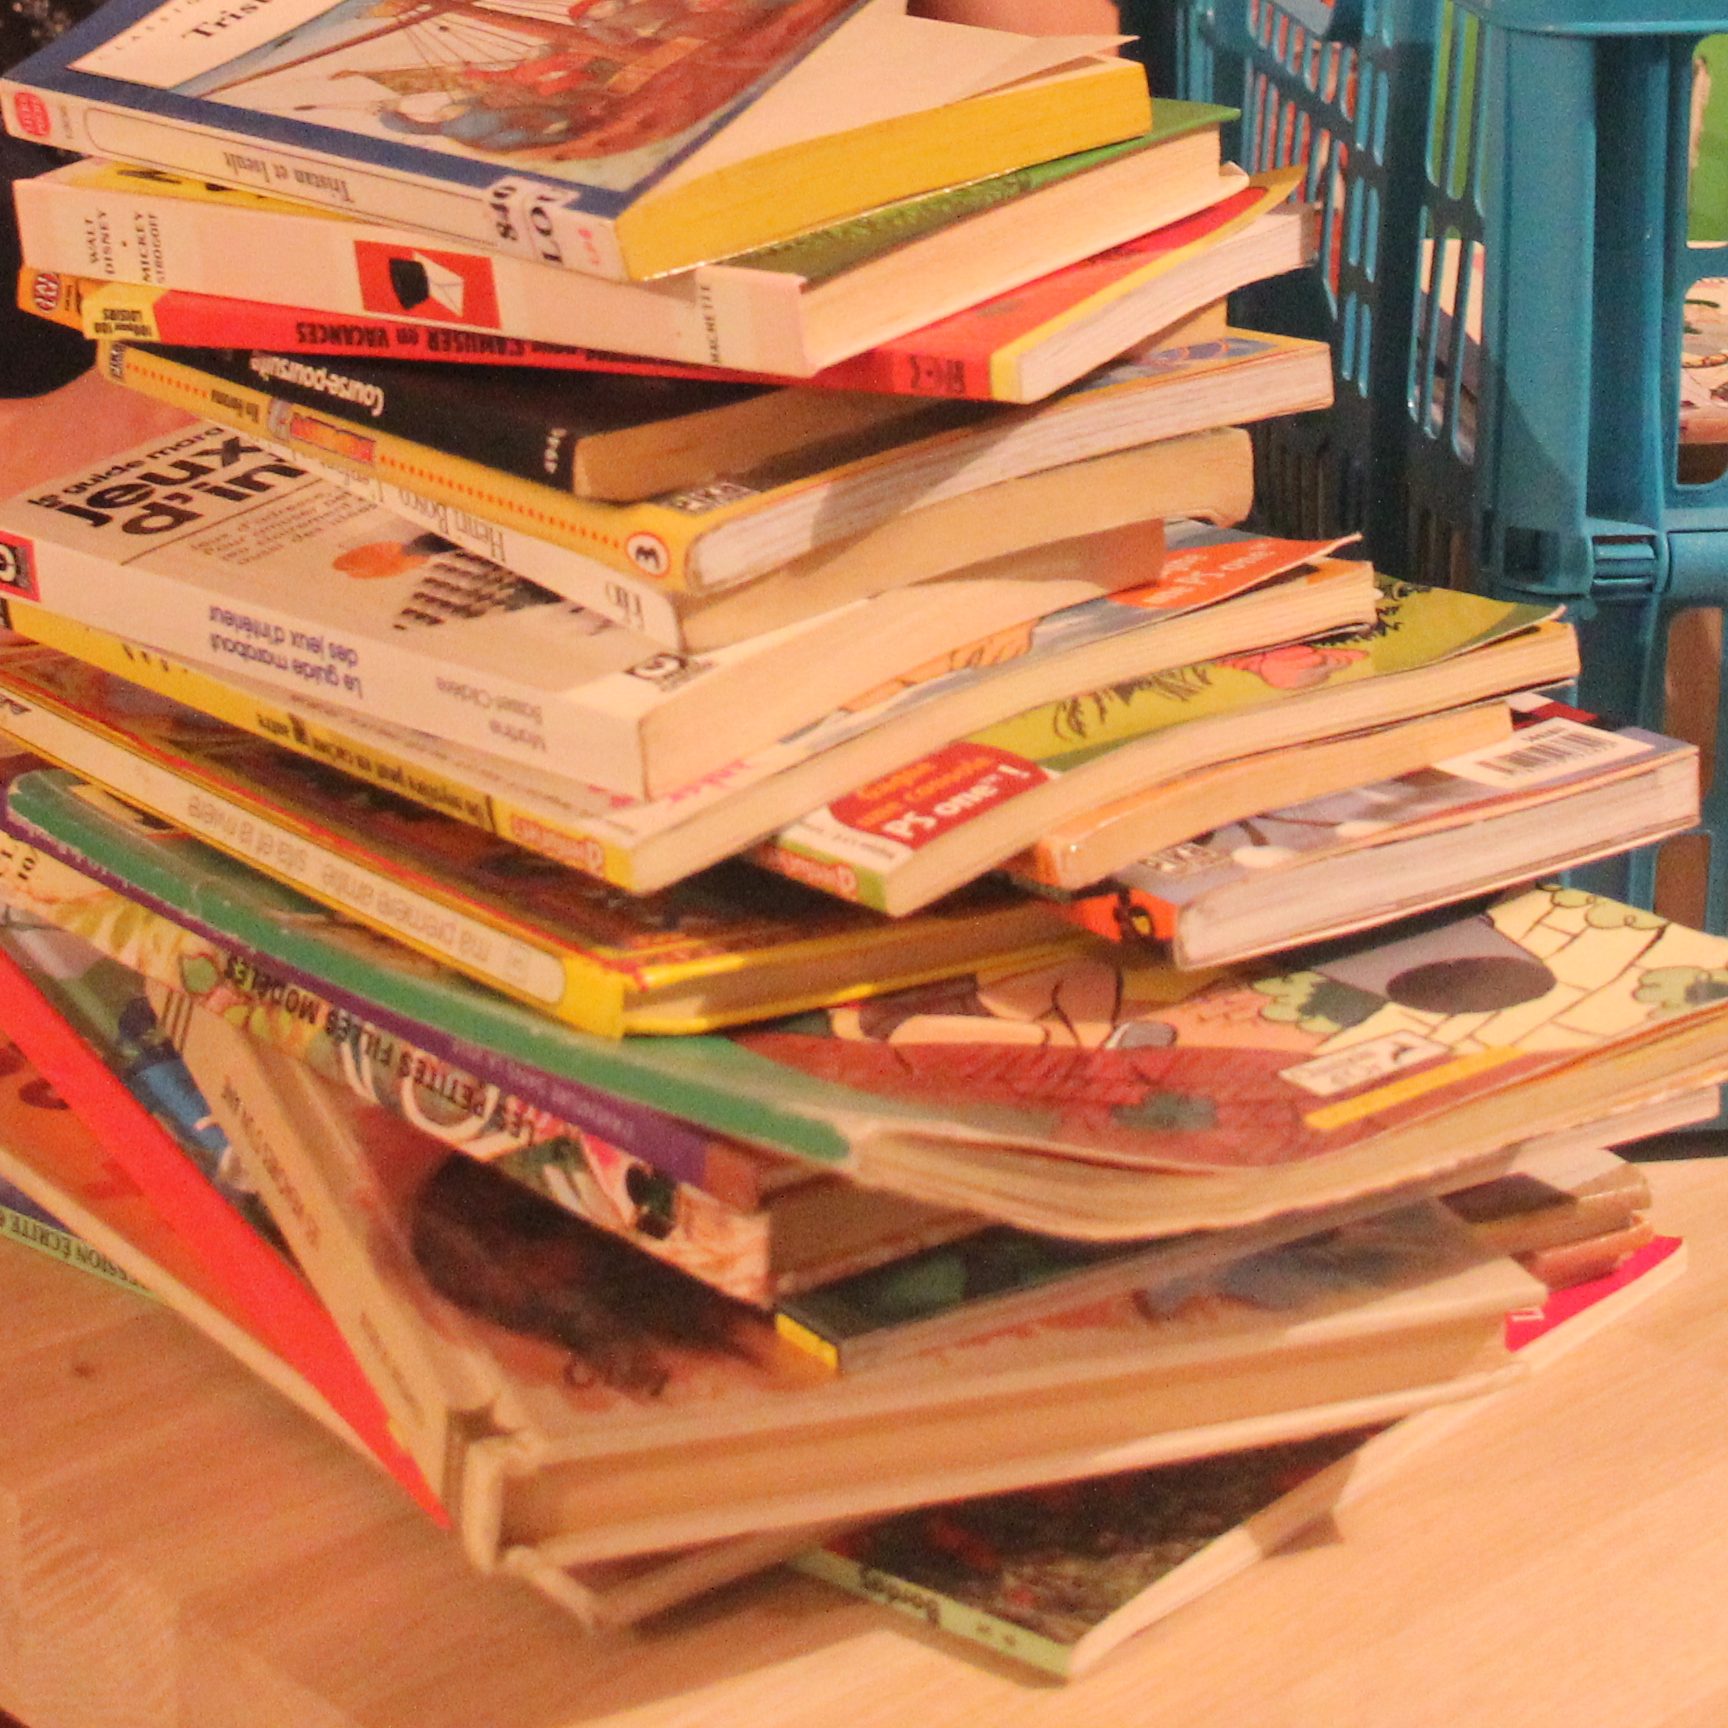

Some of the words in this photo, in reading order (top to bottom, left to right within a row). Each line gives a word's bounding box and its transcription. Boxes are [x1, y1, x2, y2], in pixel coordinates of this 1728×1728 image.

[222, 150, 270, 183] Iseult
[271, 160, 290, 181] et
[295, 165, 356, 204] Tristan
[83, 216, 100, 265] WALT
[96, 209, 116, 276] DISNEY
[133, 210, 154, 284] MICKEY
[295, 322, 390, 348] VACANCES
[250, 348, 385, 417] Course-poursuite
[28, 492, 62, 510] le
[62, 456, 147, 497] guide
[147, 425, 226, 462] mara
[55, 435, 265, 529] jeux
[120, 456, 312, 536] d'in
[455, 507, 507, 563] Henri
[208, 604, 286, 646] d'intérieur
[288, 627, 324, 659] jeux
[209, 632, 290, 672] marabout
[291, 657, 341, 688] guide
[328, 640, 360, 669] des
[880, 810, 939, 840] PS
[220, 950, 320, 1026] MODÈLES
[324, 1009, 400, 1069] FILLES
[398, 1049, 490, 1118] PETITES
[10, 1211, 73, 1259] ÉCRITE
